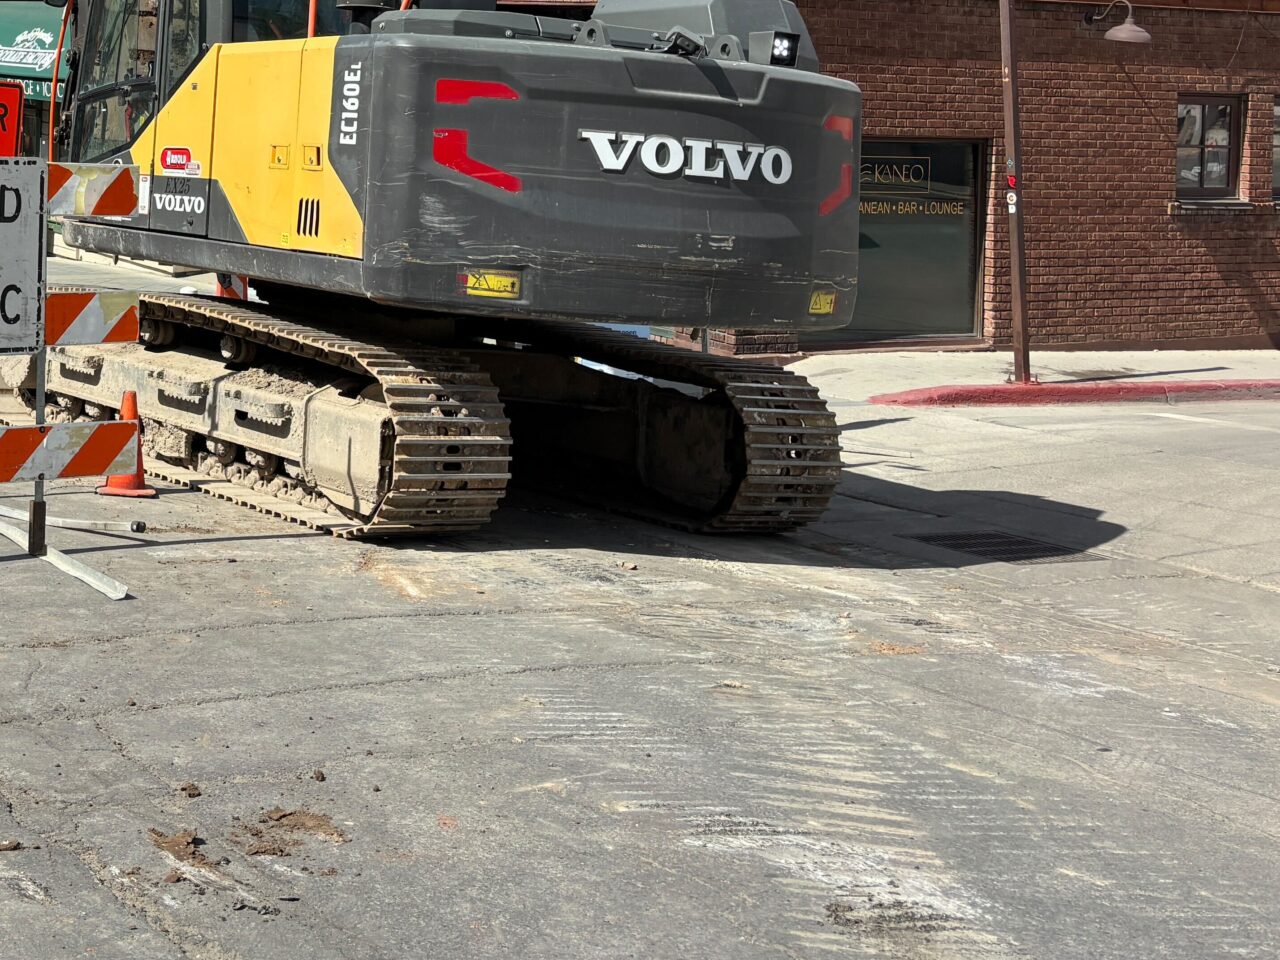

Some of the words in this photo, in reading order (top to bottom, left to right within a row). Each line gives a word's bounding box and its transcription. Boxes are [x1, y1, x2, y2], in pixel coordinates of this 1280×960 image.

[339, 61, 362, 145] EC160EL
[578, 128, 794, 185] VOLVO
[874, 163, 925, 183] KANEO
[164, 178, 192, 194] EX25
[153, 193, 206, 214] VOLVO
[898, 201, 917, 215] BAR
[924, 202, 964, 215] LOUNGE
